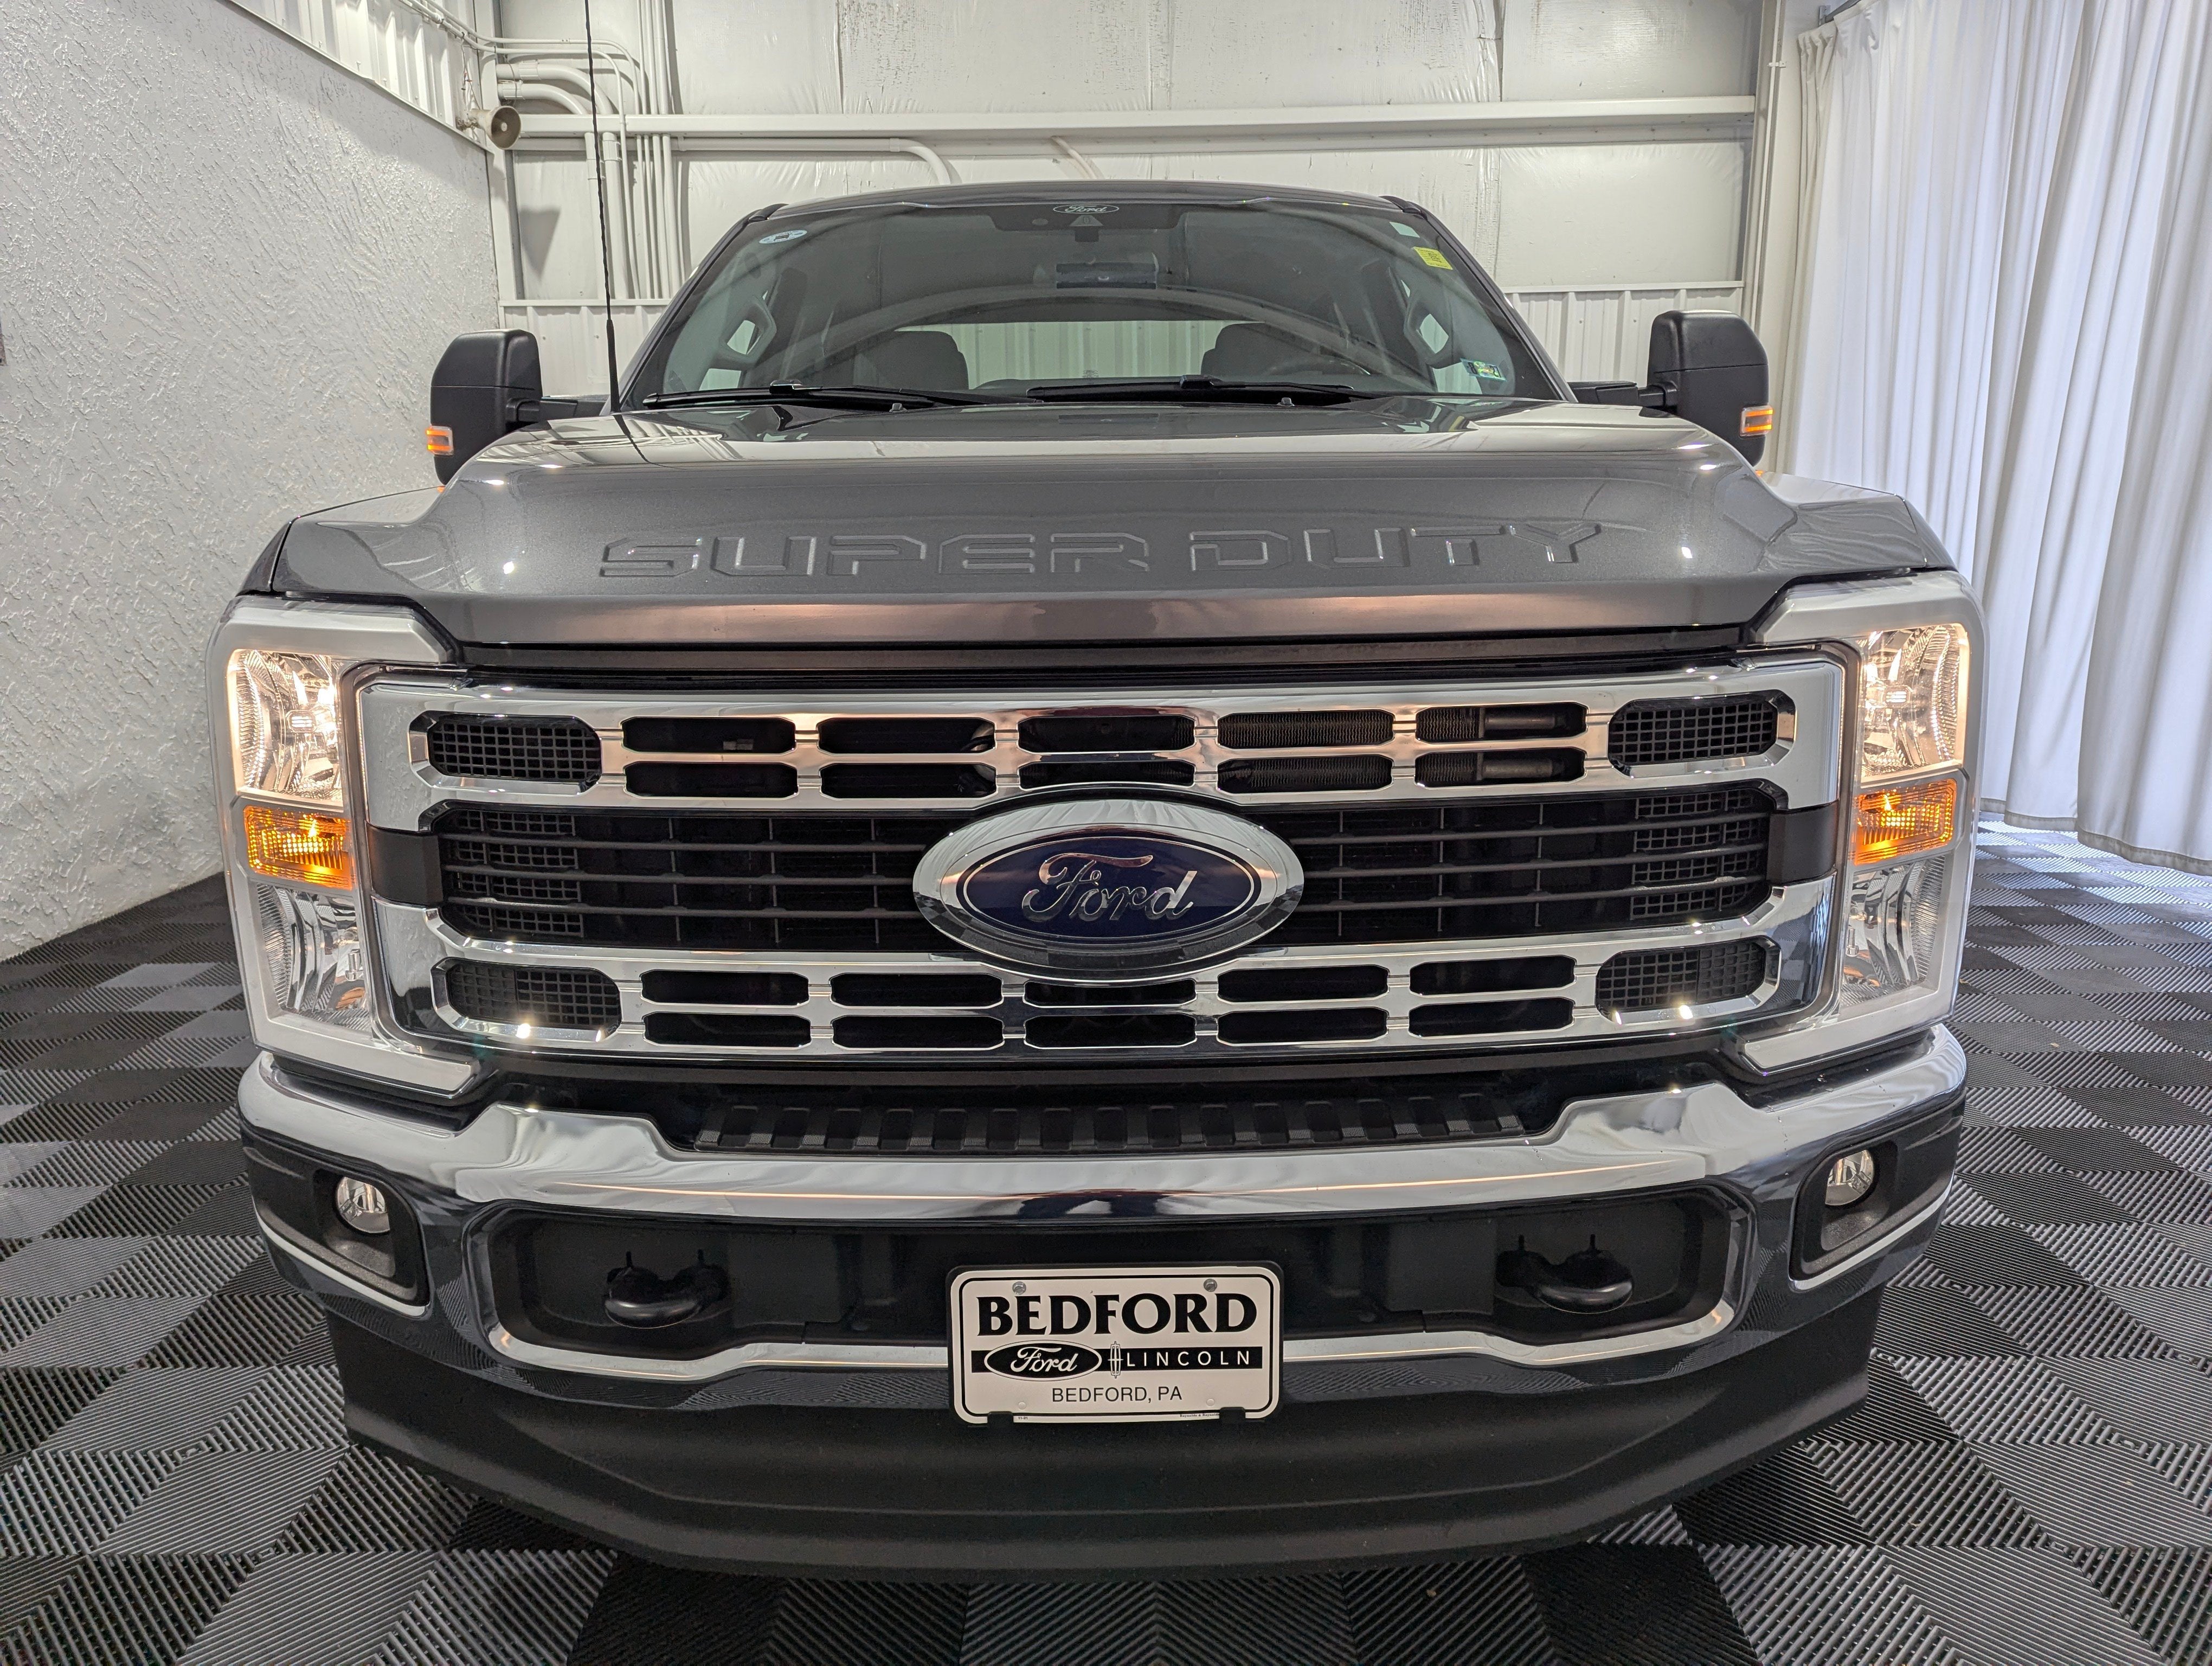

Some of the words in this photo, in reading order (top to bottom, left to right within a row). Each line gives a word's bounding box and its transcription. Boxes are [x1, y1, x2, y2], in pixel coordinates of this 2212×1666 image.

[600, 533, 1149, 577] SUPER
[1189, 521, 1602, 571] DUTY
[1021, 853, 1197, 922] Ford
[976, 1293, 1257, 1336] BEDFORD
[1010, 1347, 1078, 1372] Ford
[1127, 1351, 1250, 1367] LINCOLN
[1052, 1387, 1152, 1403] BEDFORD,
[1159, 1386, 1182, 1401] PA
